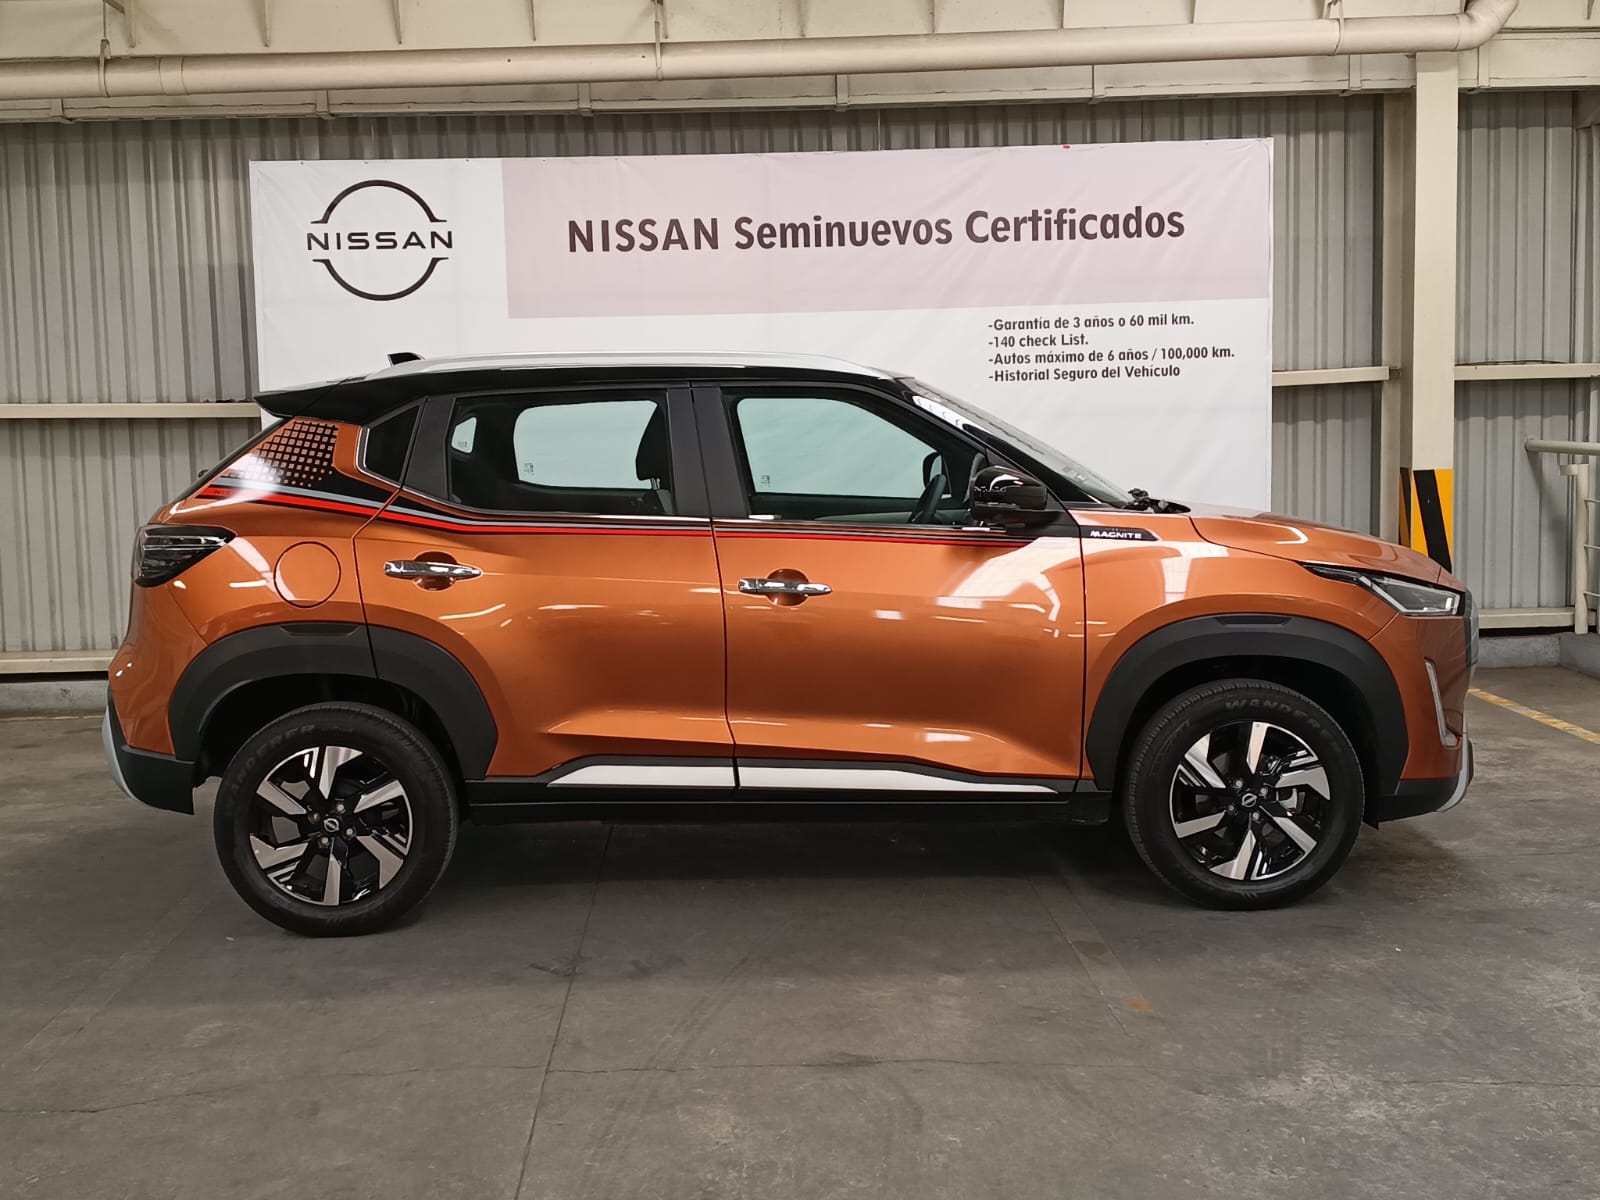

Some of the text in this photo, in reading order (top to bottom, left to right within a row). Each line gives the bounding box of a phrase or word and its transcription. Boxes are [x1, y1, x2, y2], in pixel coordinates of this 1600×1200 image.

[568, 205, 1185, 253] NISSAN Seminuevos Certificados
[306, 230, 453, 251] NISSAN
[988, 313, 1195, 331] -Garantía de 3 años o 60 mil km.
[988, 333, 1089, 348] -140 check List.
[988, 346, 1235, 365] -Autos máximo de 6 años / 100,000 km.
[988, 364, 1181, 382] -Historial Seguro del Vehículo
[1089, 530, 1142, 539] MAGNITE
